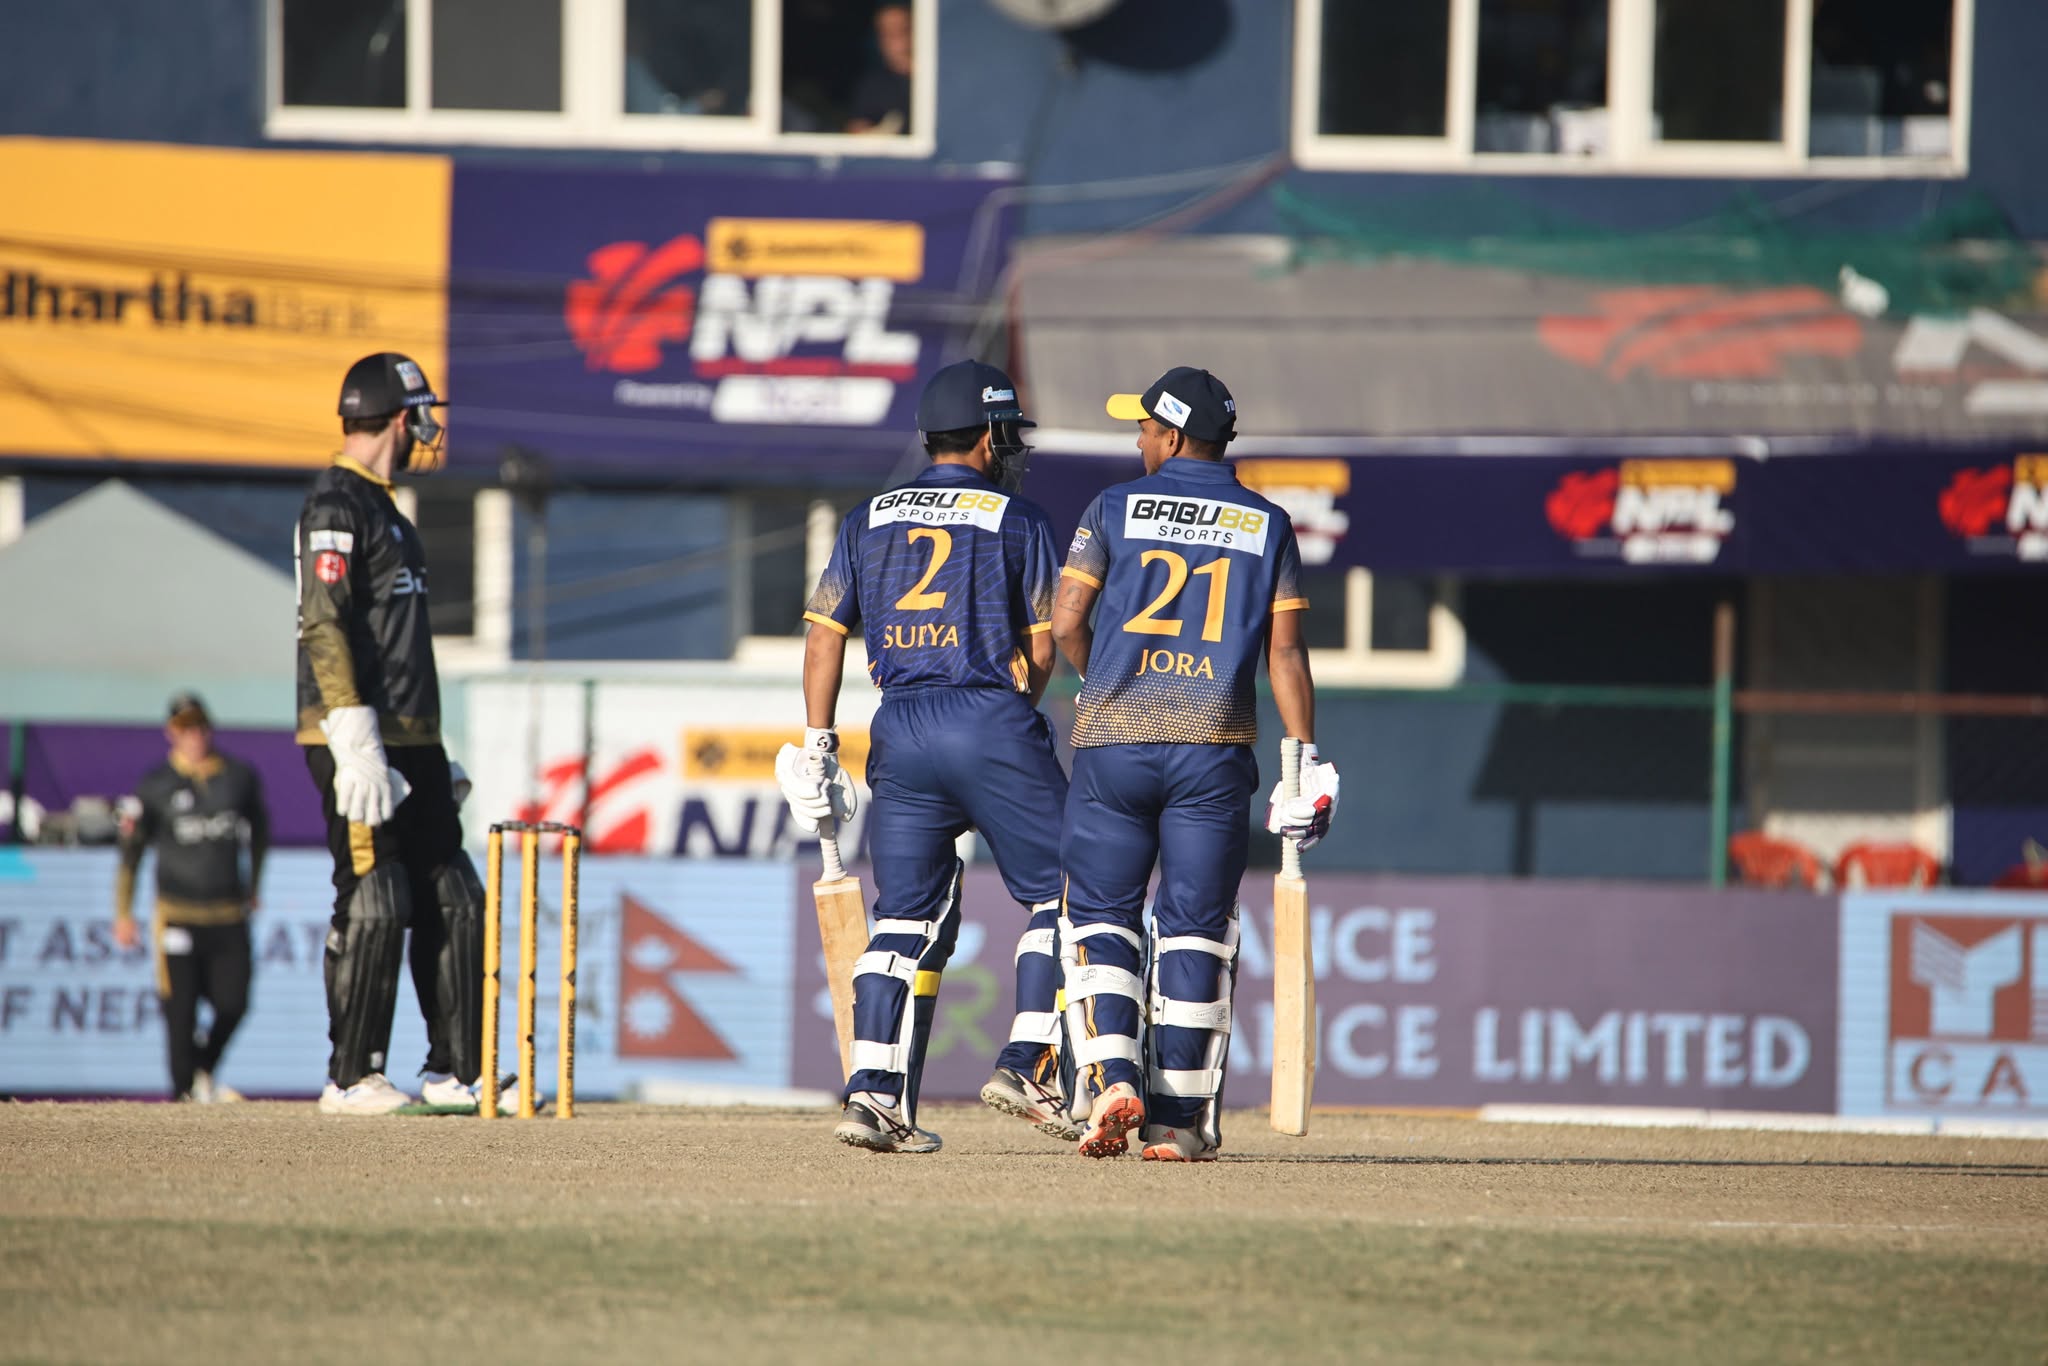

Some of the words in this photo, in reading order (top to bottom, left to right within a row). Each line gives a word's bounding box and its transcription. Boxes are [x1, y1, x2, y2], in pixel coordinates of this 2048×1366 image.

[690, 274, 920, 364] NPL
[875, 490, 1003, 513] BABU88
[897, 508, 970, 522] SPORTS
[1131, 498, 1265, 535] BABU88
[1611, 484, 1736, 534] NPL
[1158, 525, 1234, 544] SPORTS
[895, 527, 952, 611] 2
[1122, 549, 1232, 643] 21
[1136, 648, 1215, 680] JORA
[1471, 1006, 1812, 1089] LIMITED
